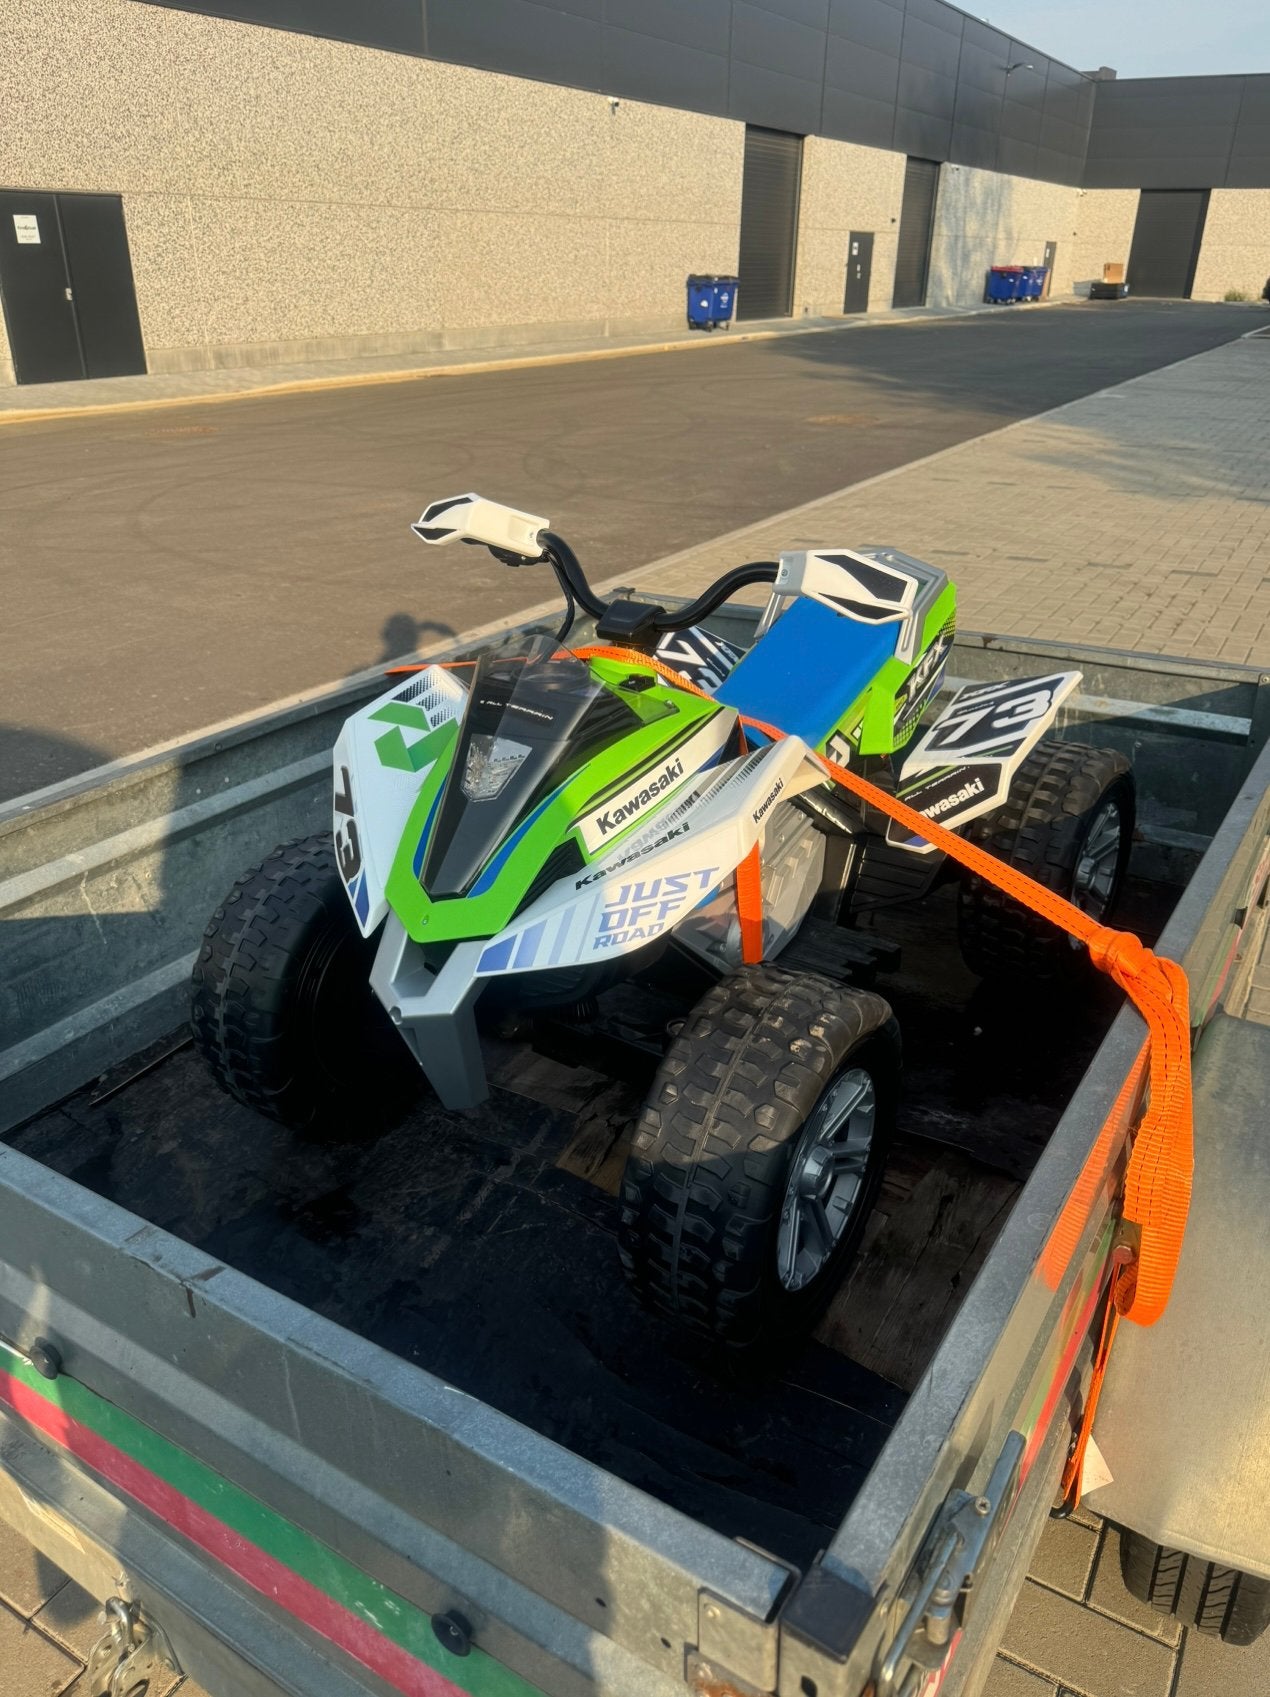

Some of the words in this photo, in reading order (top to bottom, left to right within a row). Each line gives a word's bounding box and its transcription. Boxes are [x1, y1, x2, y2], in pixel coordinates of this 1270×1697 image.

[935, 690, 1052, 747] 73
[596, 758, 685, 835] Kawasaki
[752, 777, 785, 824] Kawasaki
[920, 777, 985, 819] wasaki
[575, 821, 691, 891] Kawasaki
[604, 866, 720, 908] JUST
[592, 922, 664, 951] ROAD
[598, 895, 687, 934] OFF
